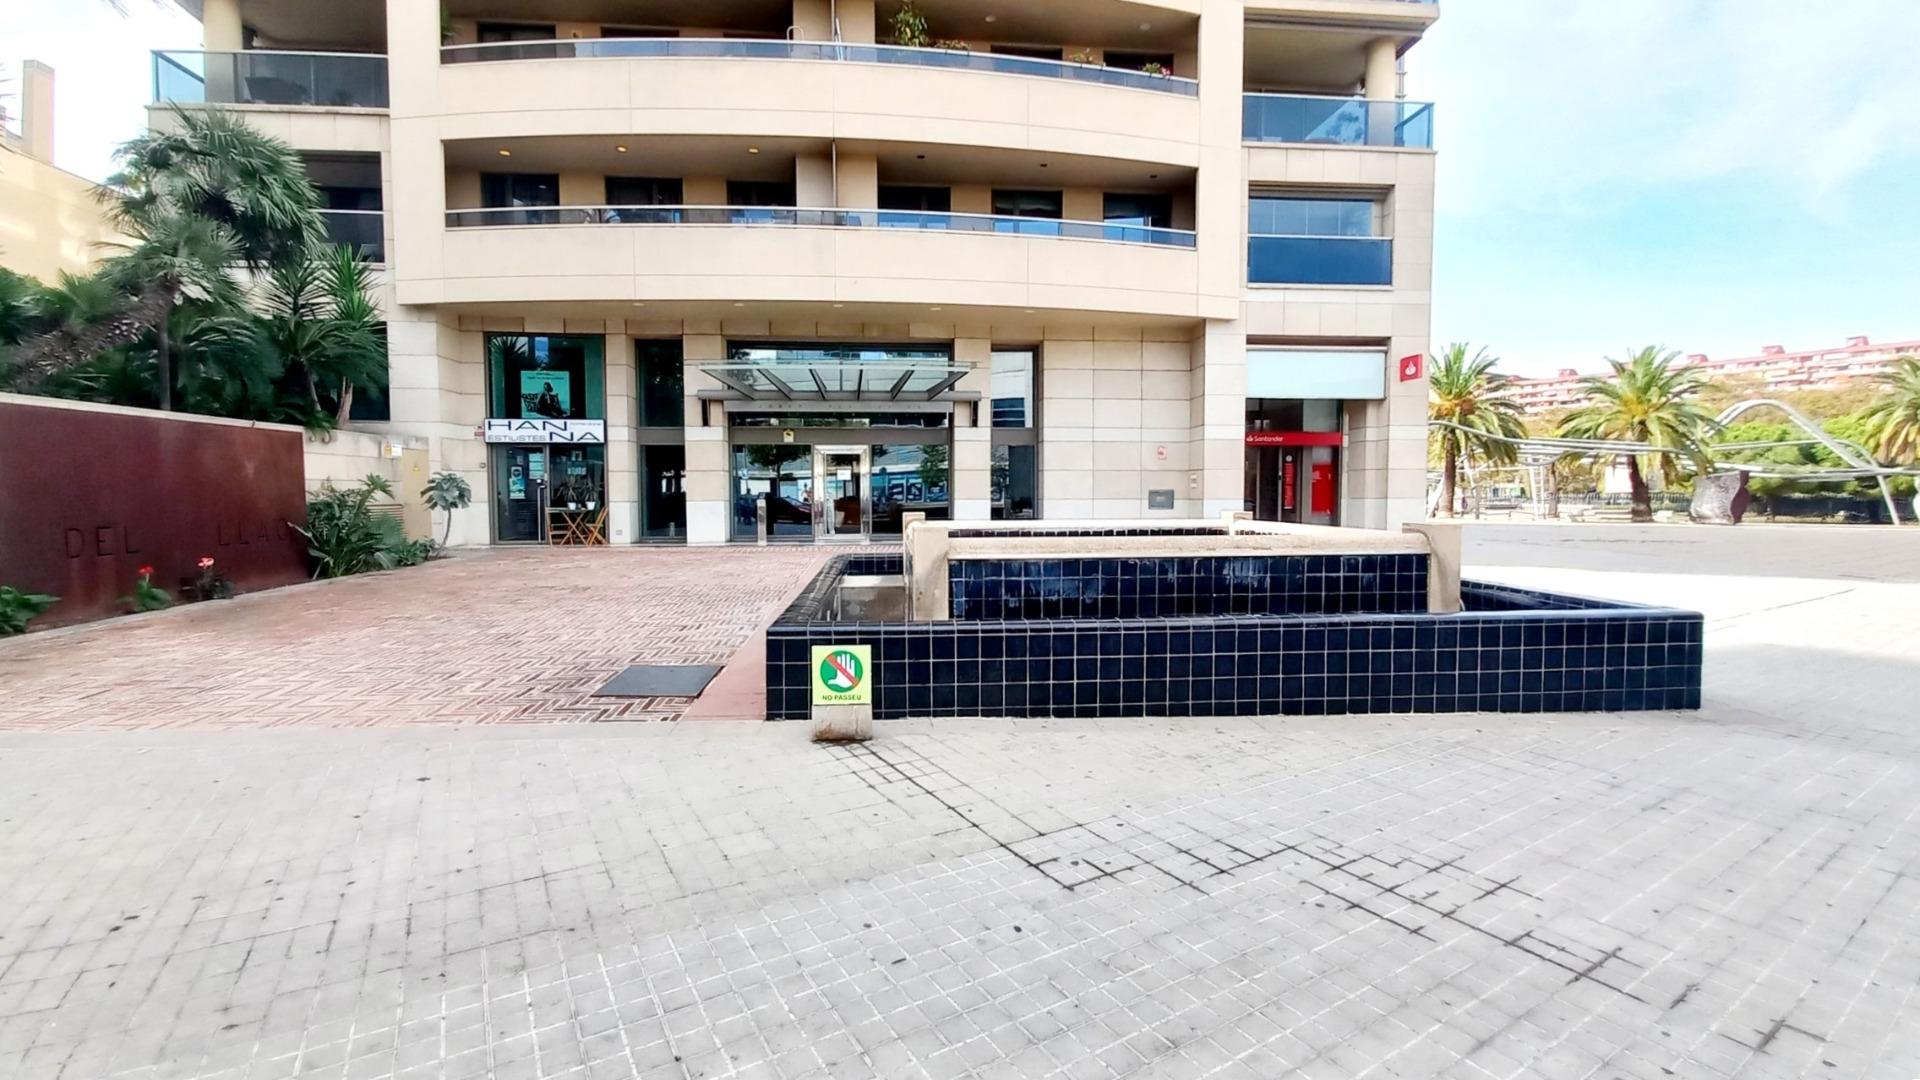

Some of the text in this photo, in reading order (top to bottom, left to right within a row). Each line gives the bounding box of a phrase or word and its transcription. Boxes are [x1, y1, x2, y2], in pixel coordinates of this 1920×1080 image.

[488, 420, 567, 431] HAN
[549, 432, 600, 442] NA
[64, 526, 141, 559] DEL
